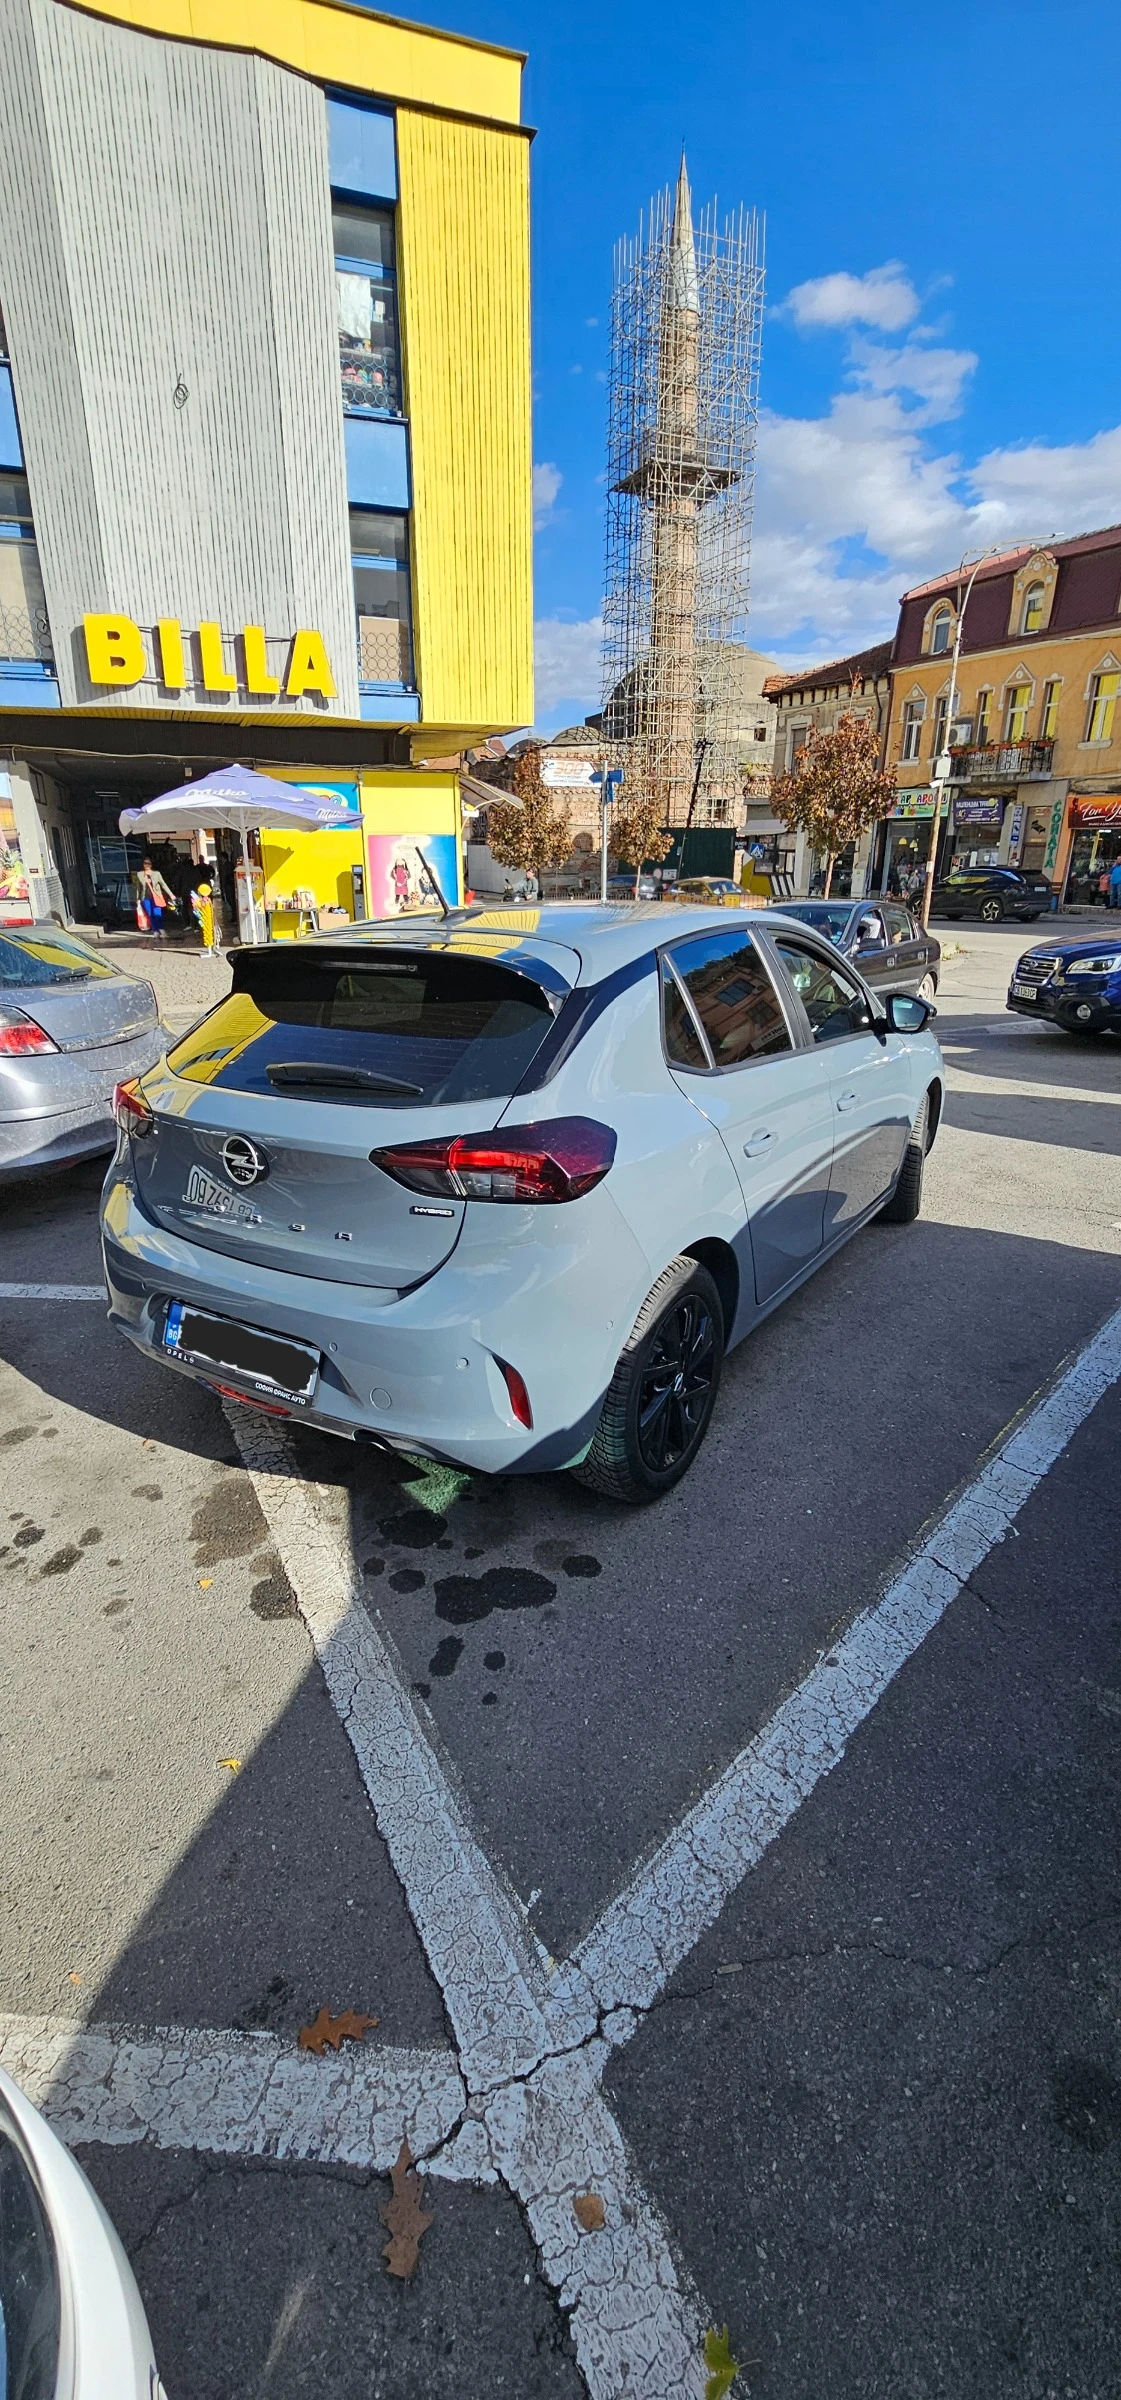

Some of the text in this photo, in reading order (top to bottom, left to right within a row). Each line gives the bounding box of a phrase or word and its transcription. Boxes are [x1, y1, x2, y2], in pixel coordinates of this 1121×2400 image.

[83, 612, 338, 698] BILLA
[553, 762, 584, 775] 300
[184, 788, 250, 797] Milka
[315, 808, 347, 821] Milka
[1044, 799, 1062, 868] СОНАТА
[414, 1206, 453, 1216] HYBRID
[168, 1328, 178, 1341] BG
[167, 1348, 188, 1362] OPEL
